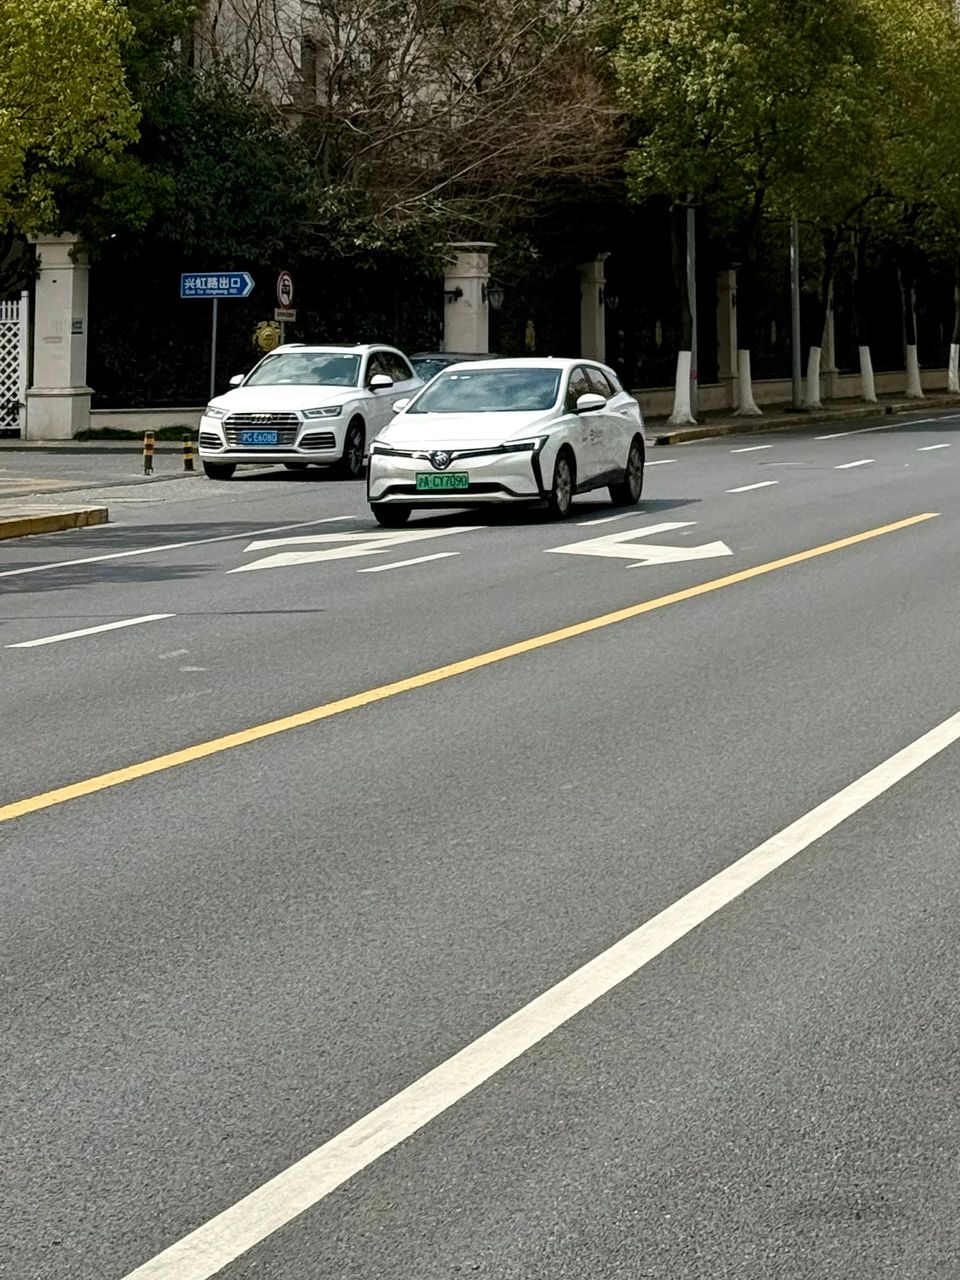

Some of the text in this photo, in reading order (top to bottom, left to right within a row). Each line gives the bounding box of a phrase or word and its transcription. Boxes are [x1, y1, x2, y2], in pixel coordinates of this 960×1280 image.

[184, 277, 240, 289] 兴虹路出口
